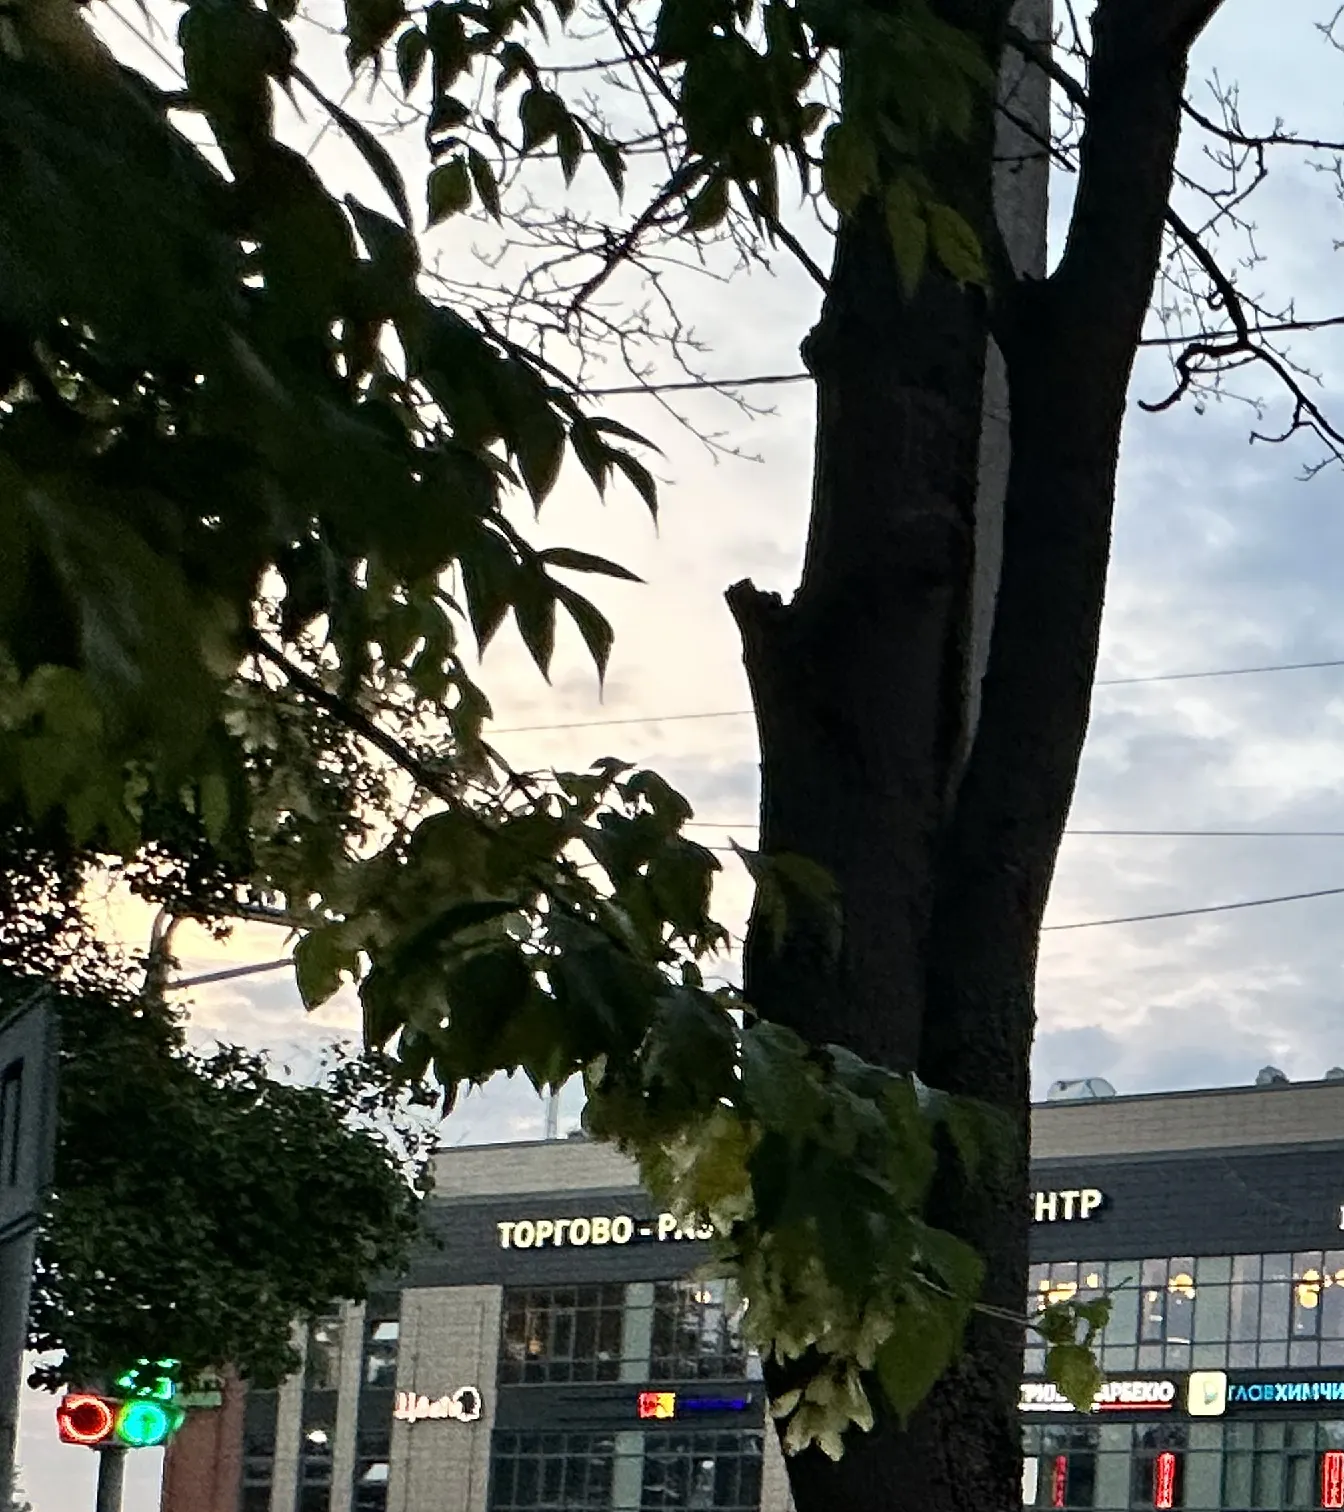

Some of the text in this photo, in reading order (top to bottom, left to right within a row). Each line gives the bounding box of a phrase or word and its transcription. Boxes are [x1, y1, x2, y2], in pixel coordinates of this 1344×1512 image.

[1034, 1188, 1102, 1222] НТР
[497, 1215, 632, 1249] ТОРГОВО
[1093, 1381, 1175, 1402] АРБЕКЮ
